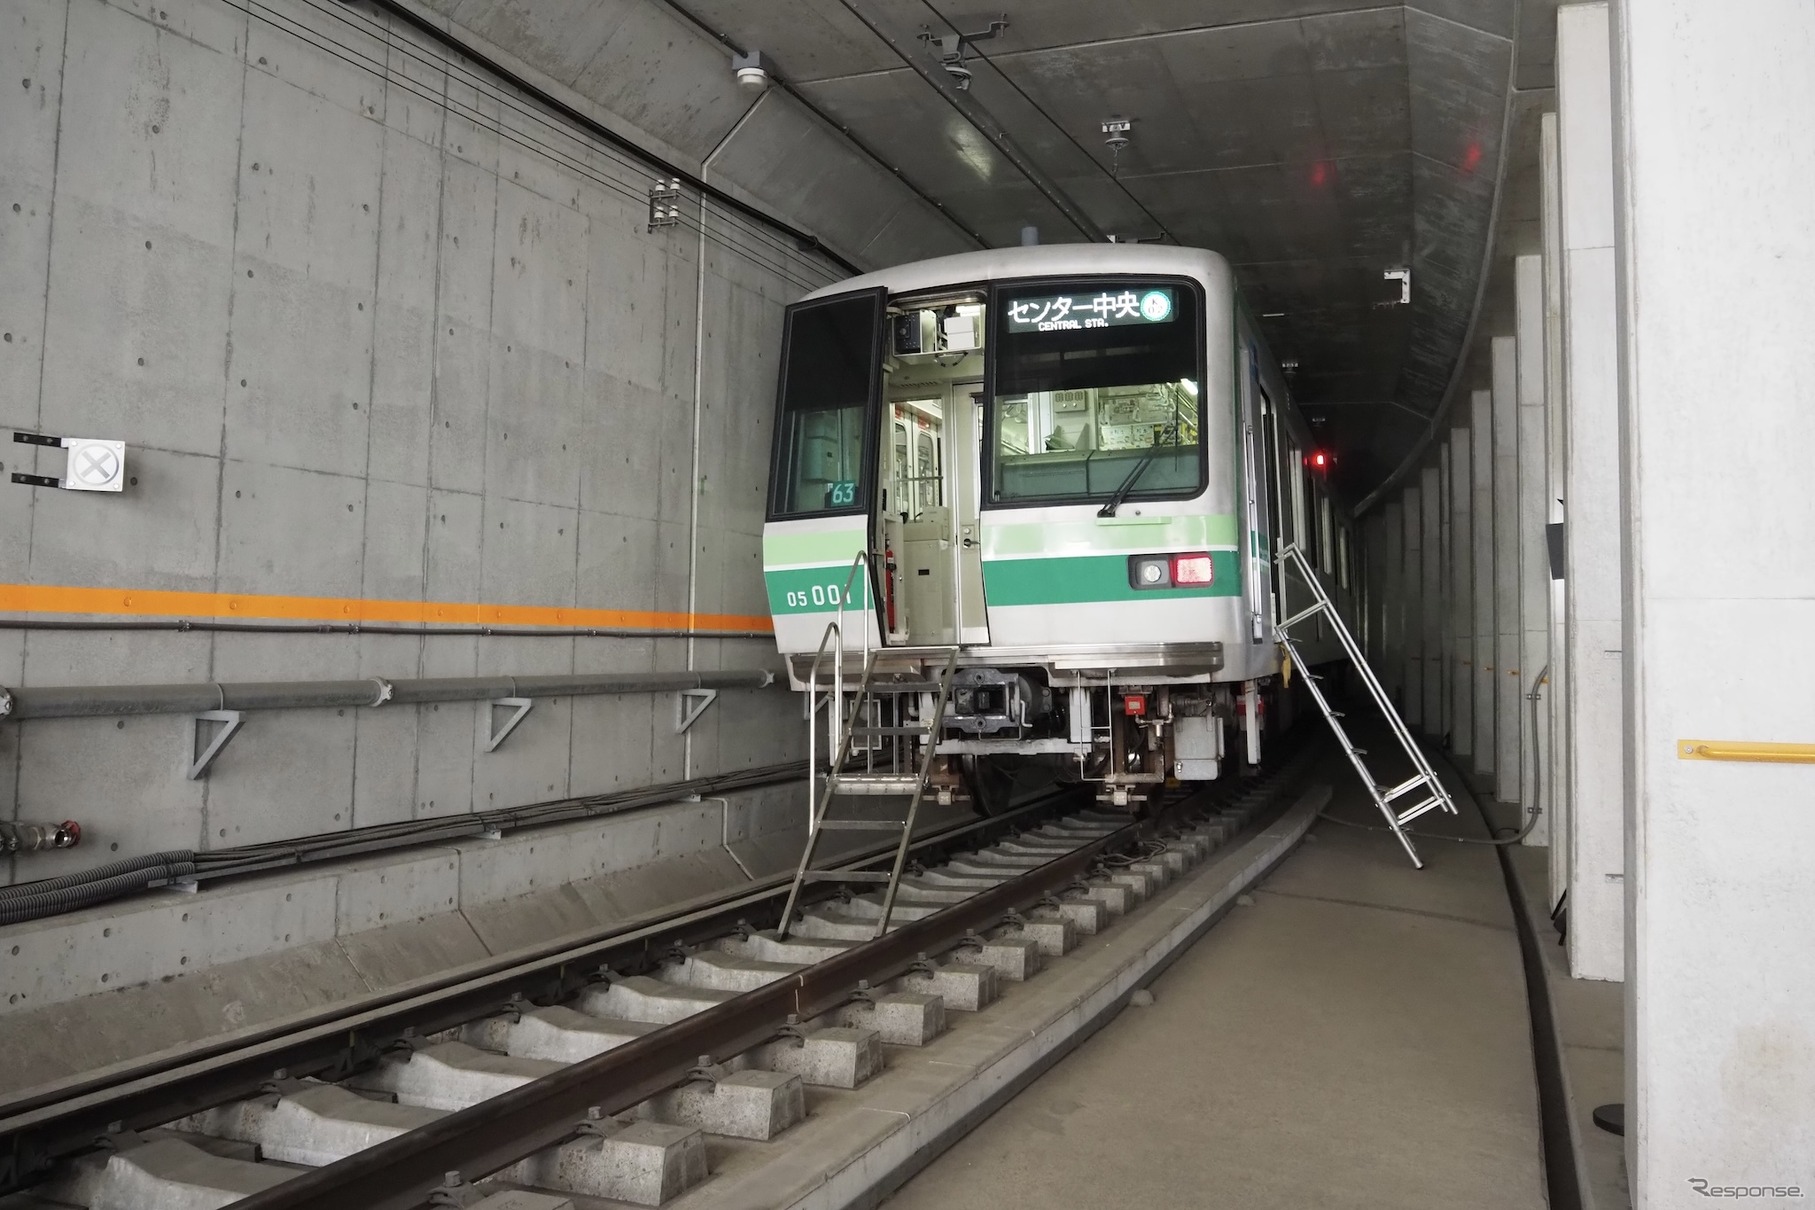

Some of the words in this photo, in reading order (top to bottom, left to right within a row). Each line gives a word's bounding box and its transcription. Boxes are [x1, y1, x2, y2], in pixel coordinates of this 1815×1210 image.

[1008, 290, 1140, 323] センター中央
[1038, 320, 1082, 332] CENTRAL
[1085, 318, 1109, 328] STA.
[832, 482, 854, 503] 63
